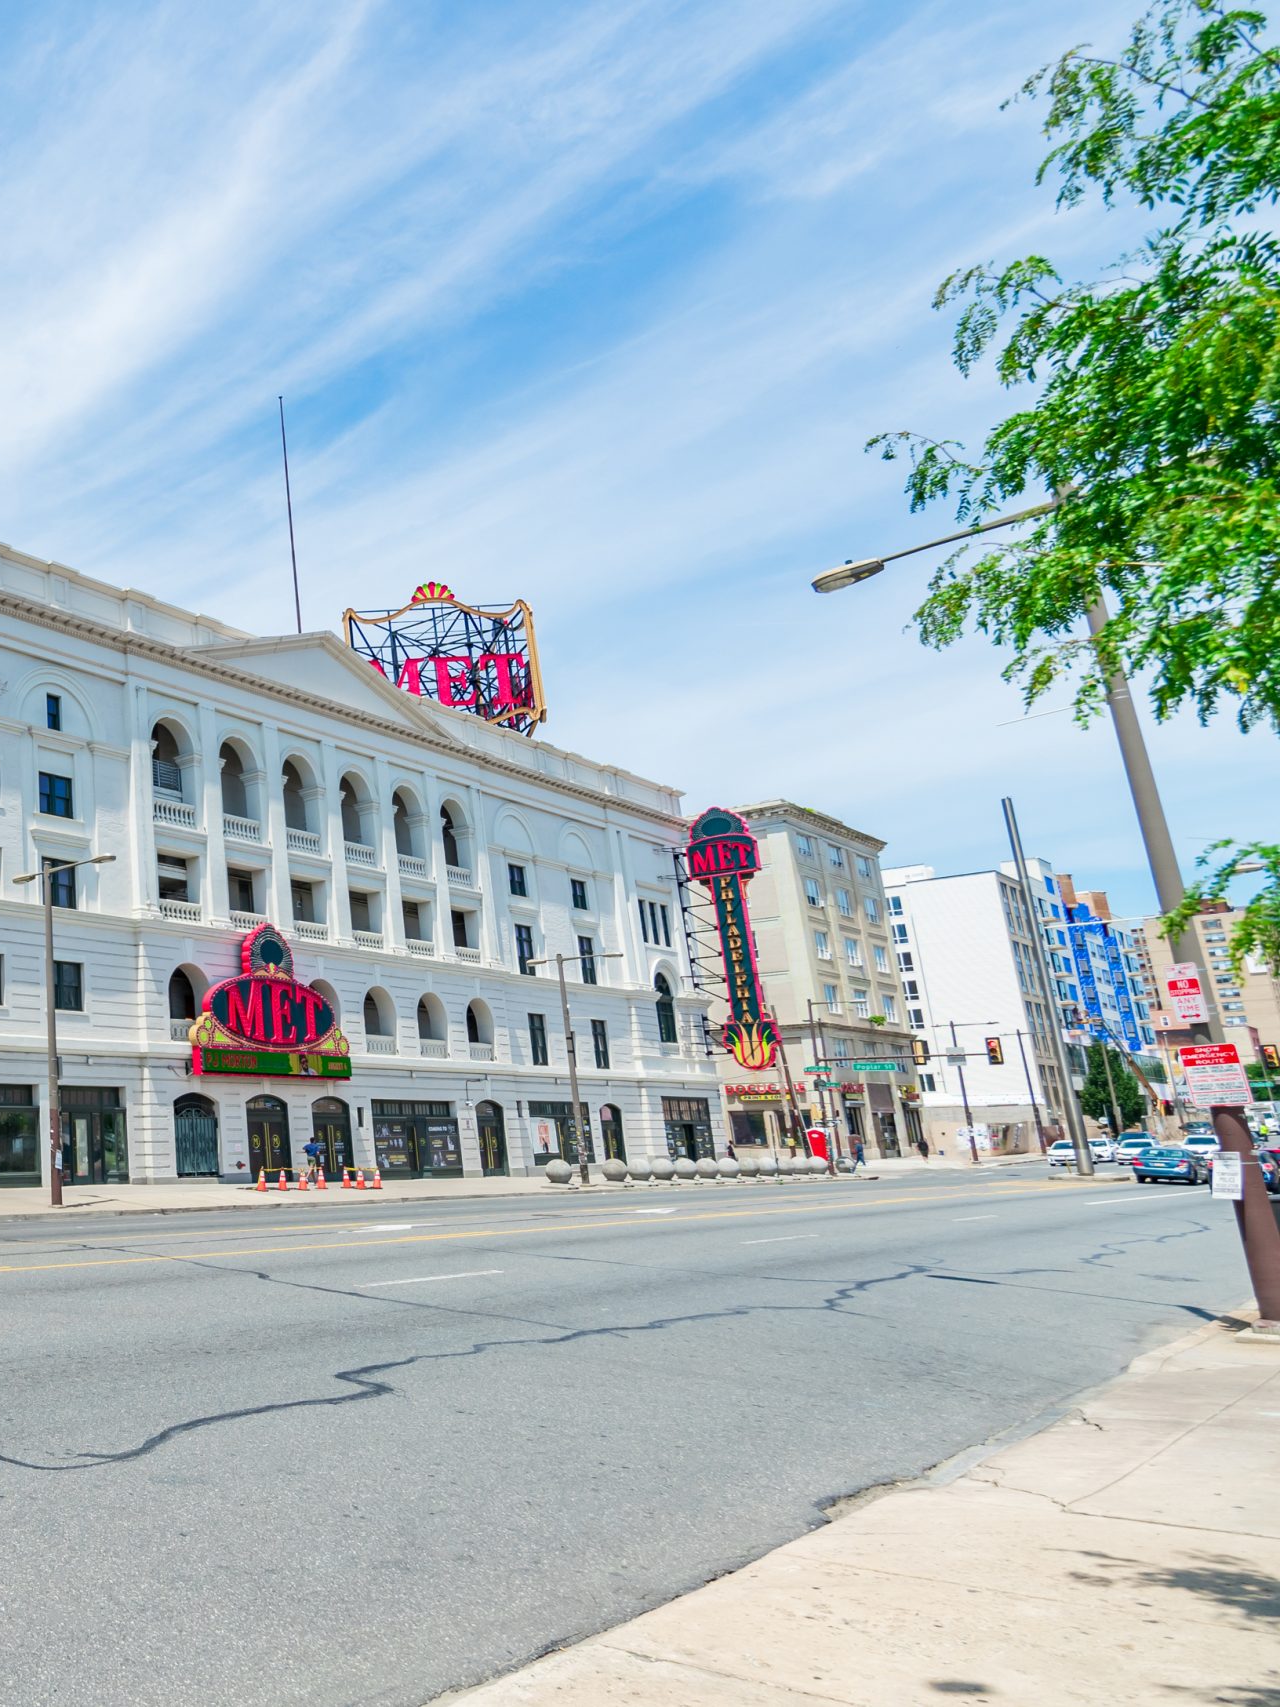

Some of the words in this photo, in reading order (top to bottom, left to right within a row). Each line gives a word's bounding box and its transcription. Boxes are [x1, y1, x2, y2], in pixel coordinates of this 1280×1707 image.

[692, 841, 750, 874] MET
[719, 876, 754, 1024] PHILADELPHIA
[1176, 980, 1189, 989] NO
[1170, 988, 1200, 996] STOPPING
[224, 980, 322, 1043] MET
[1177, 1004, 1200, 1012] TIME
[1182, 1052, 1235, 1060] EMERGENCY
